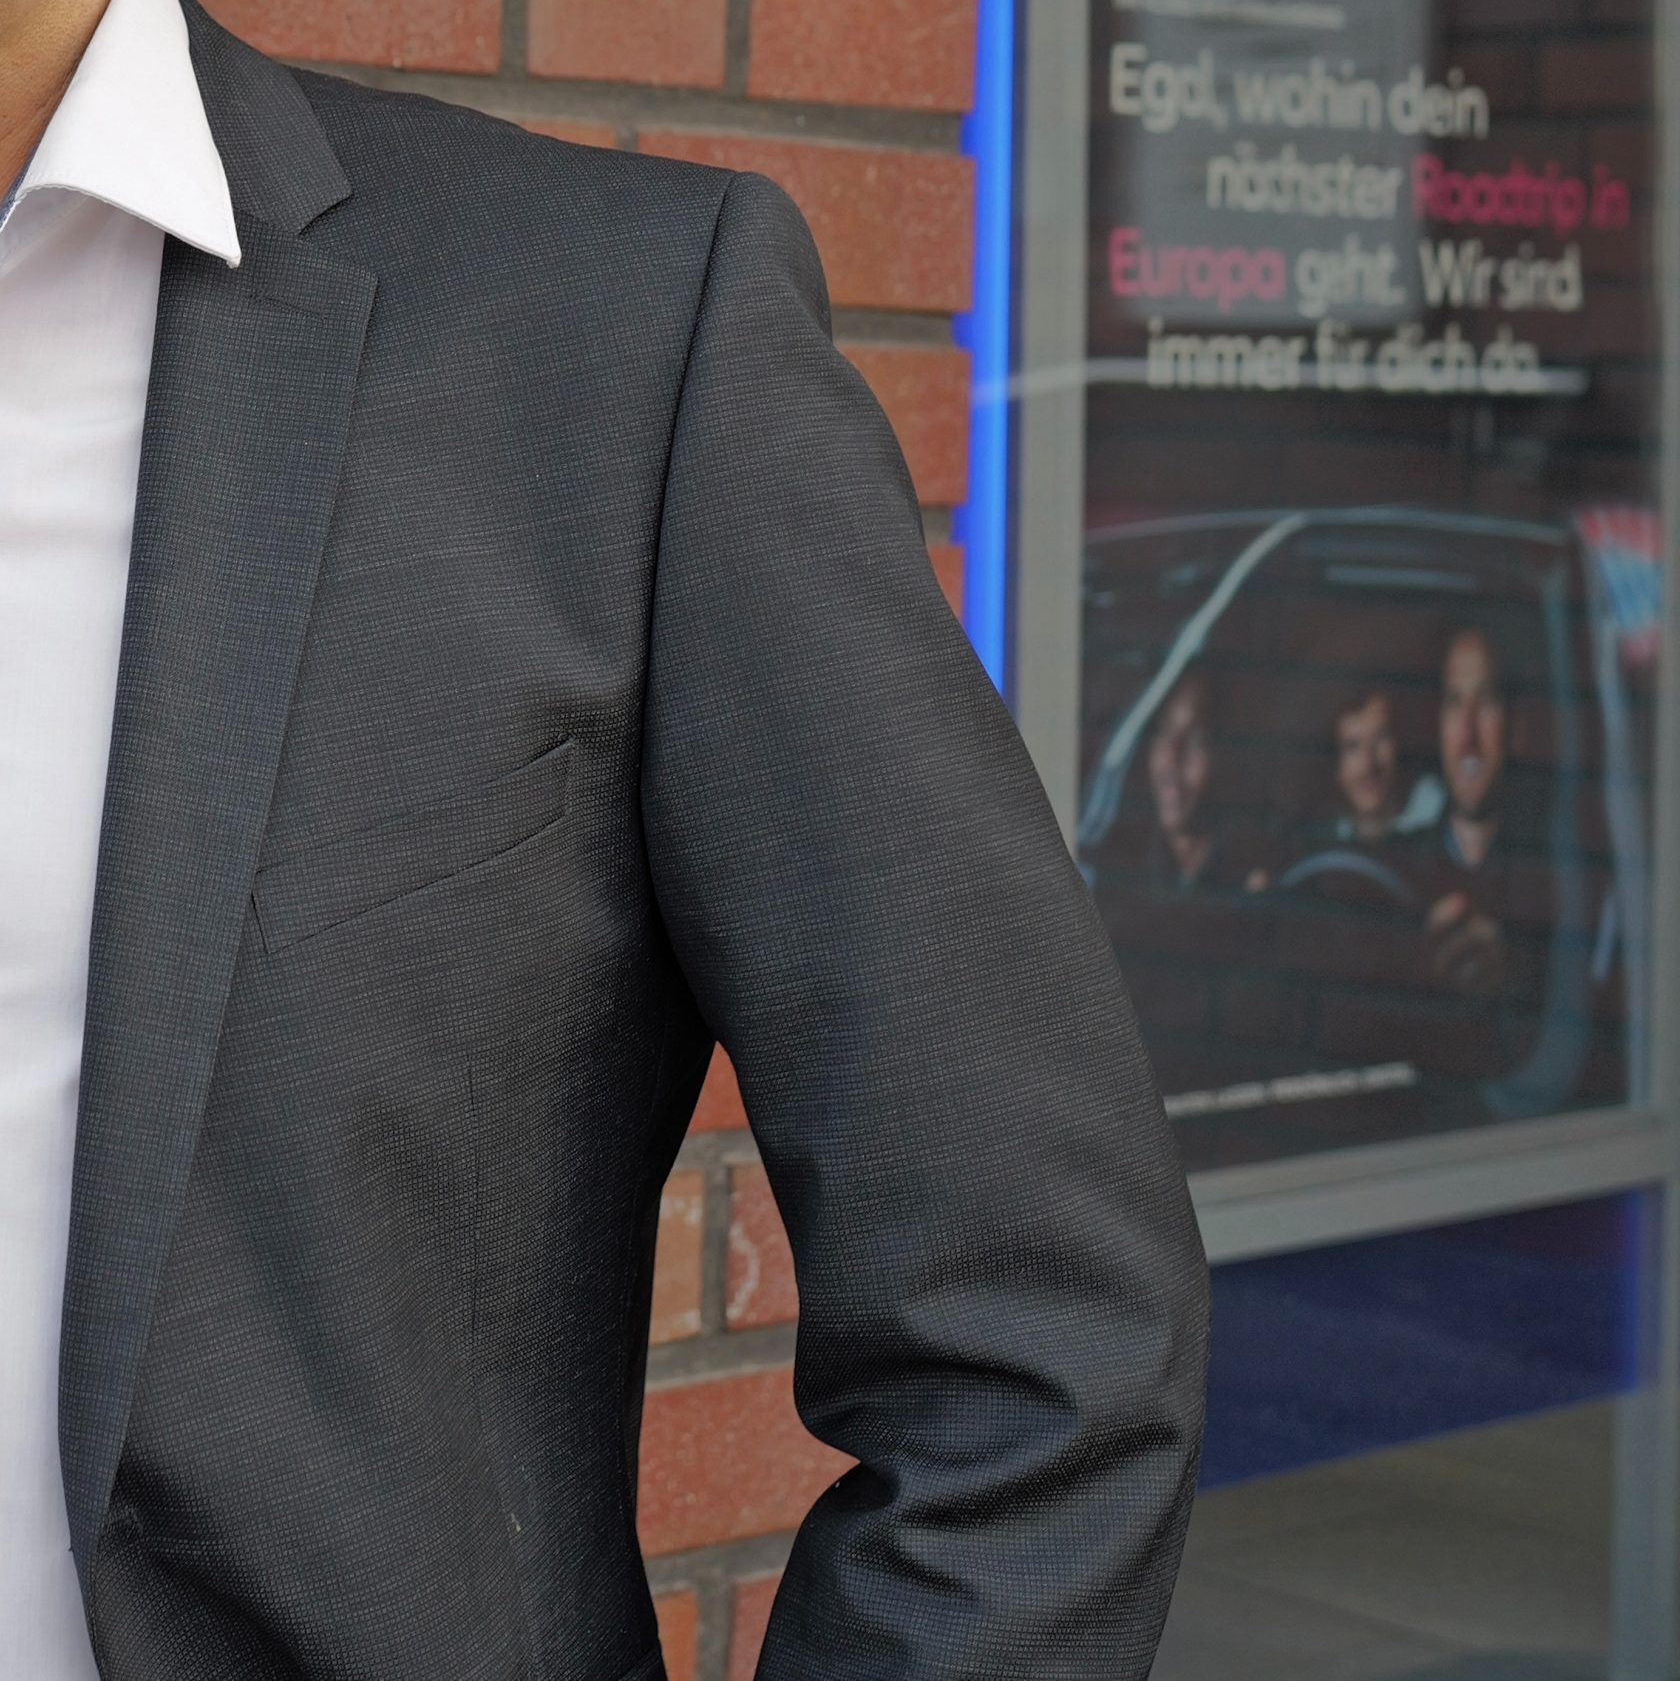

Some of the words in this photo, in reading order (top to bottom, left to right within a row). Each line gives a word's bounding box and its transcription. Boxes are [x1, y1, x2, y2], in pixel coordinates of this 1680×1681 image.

[1232, 58, 1382, 130] wohin
[1387, 64, 1489, 140] dein
[1206, 141, 1402, 219] nächster
[1412, 152, 1587, 240] Roadtrip
[1589, 164, 1632, 230] in
[1109, 226, 1287, 313] Europa
[1419, 237, 1496, 308] Wir
[1499, 242, 1584, 312] sind
[1147, 316, 1306, 391] immer
[1317, 318, 1368, 391] für
[1376, 321, 1477, 393] dich
